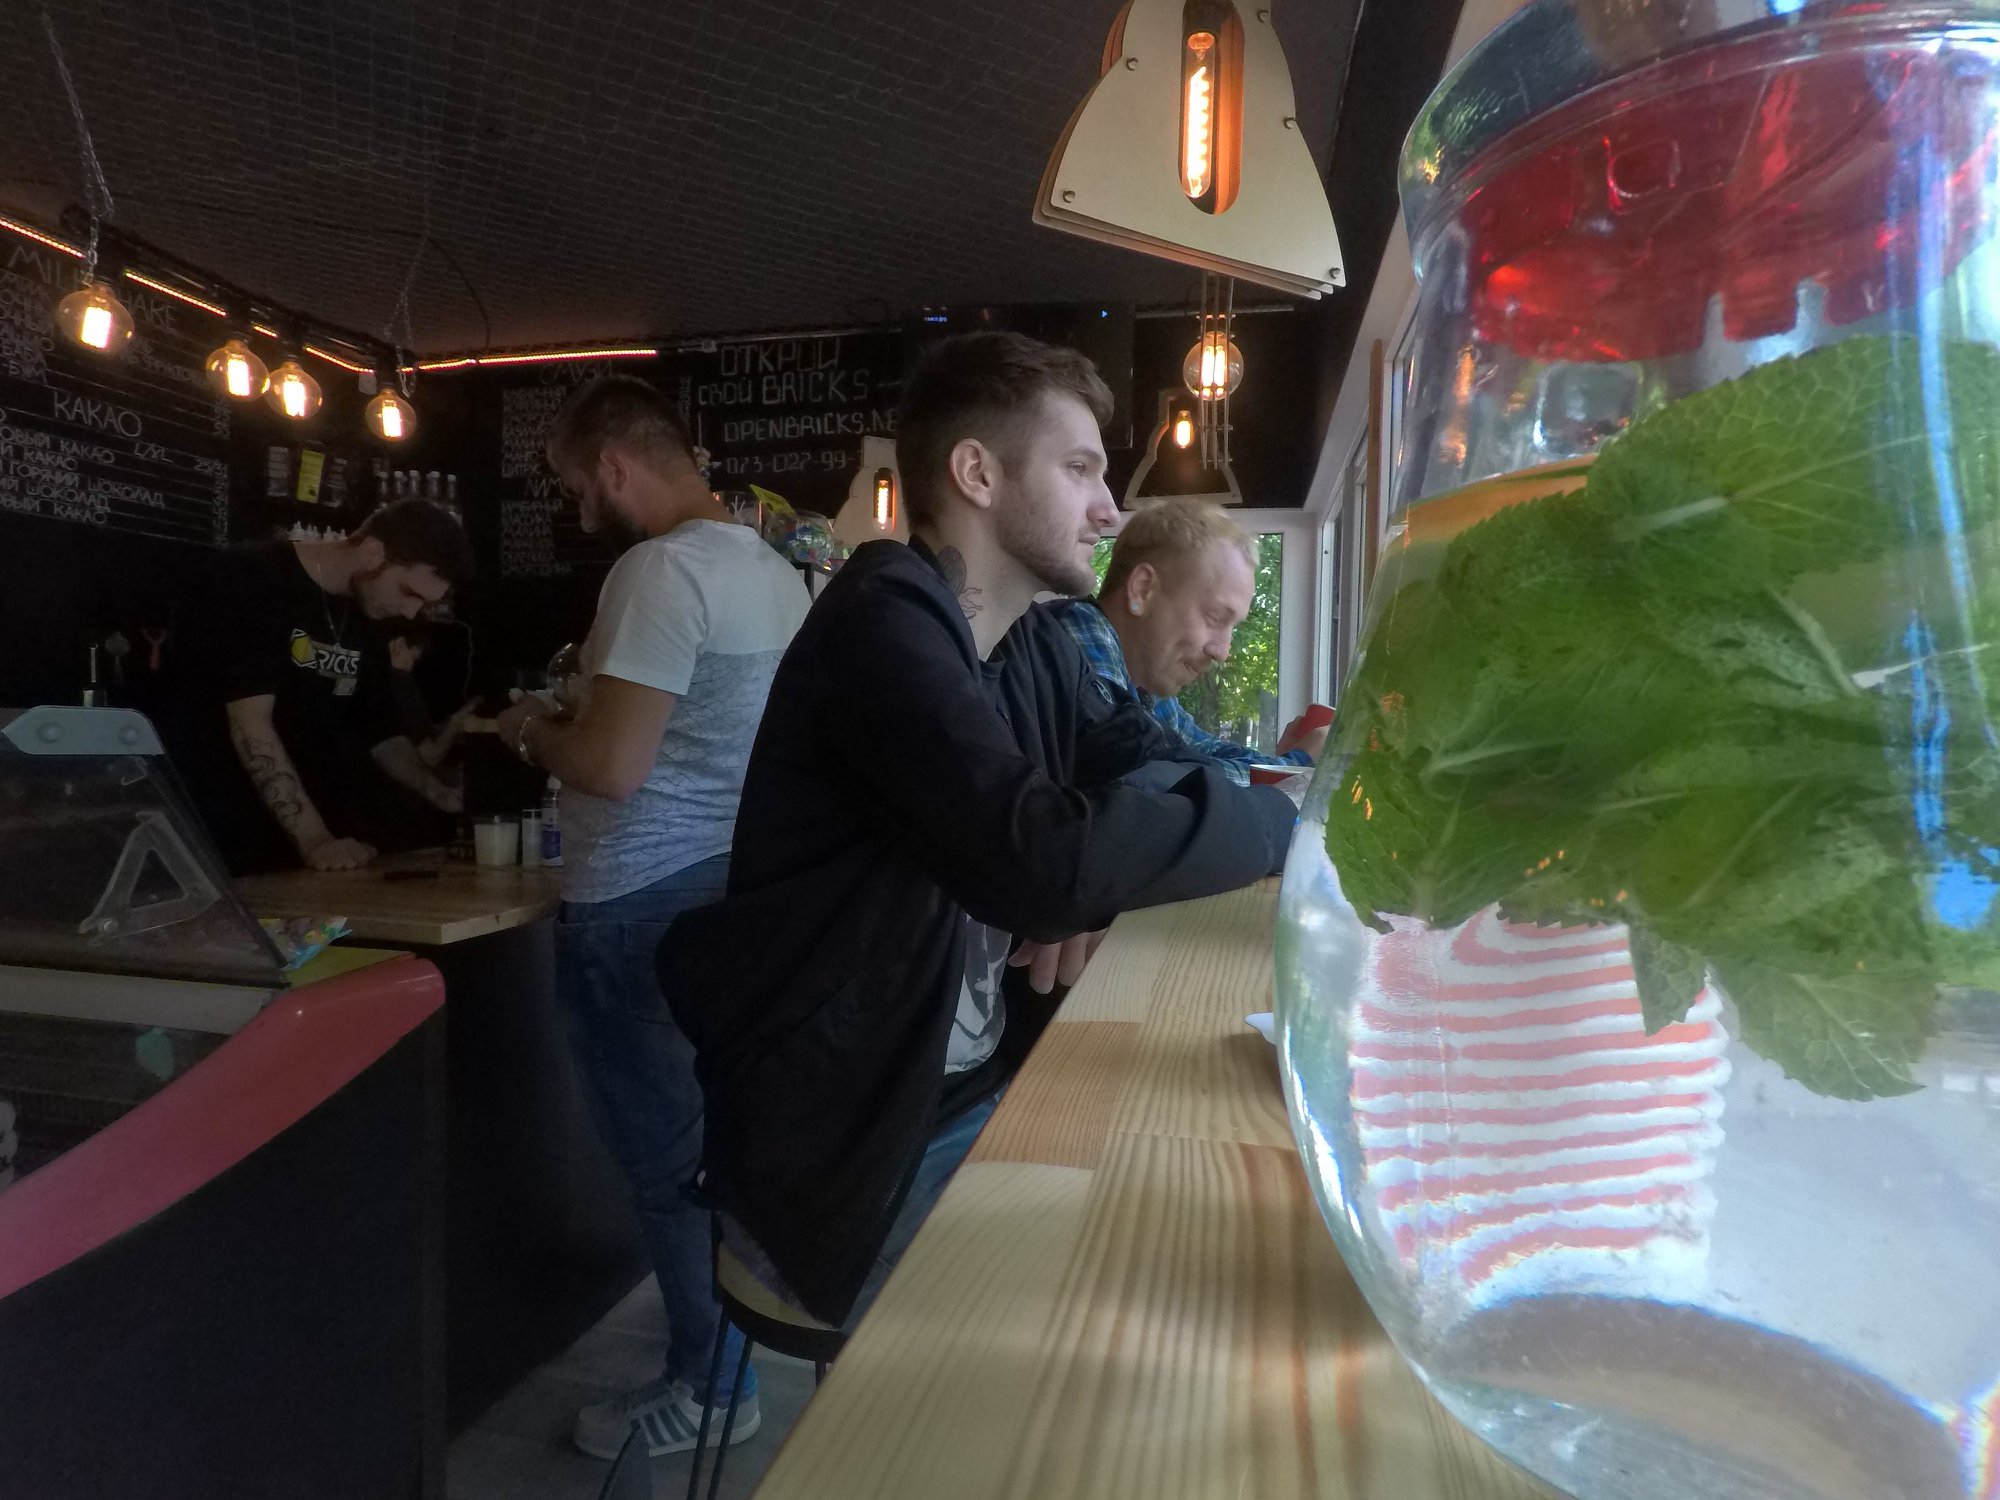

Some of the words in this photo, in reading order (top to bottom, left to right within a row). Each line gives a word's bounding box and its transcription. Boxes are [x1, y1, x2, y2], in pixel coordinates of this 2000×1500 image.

[762, 369, 870, 405] BRICKS
[53, 391, 142, 437] КАКАО
[24, 446, 78, 471] КАКАО
[60, 438, 115, 464] КАКАО
[726, 448, 862, 475] 073-027-99-
[26, 479, 111, 513] ШОКОЛАД
[87, 475, 165, 510] ШОКОЛАД
[53, 501, 108, 524] КАКАО
